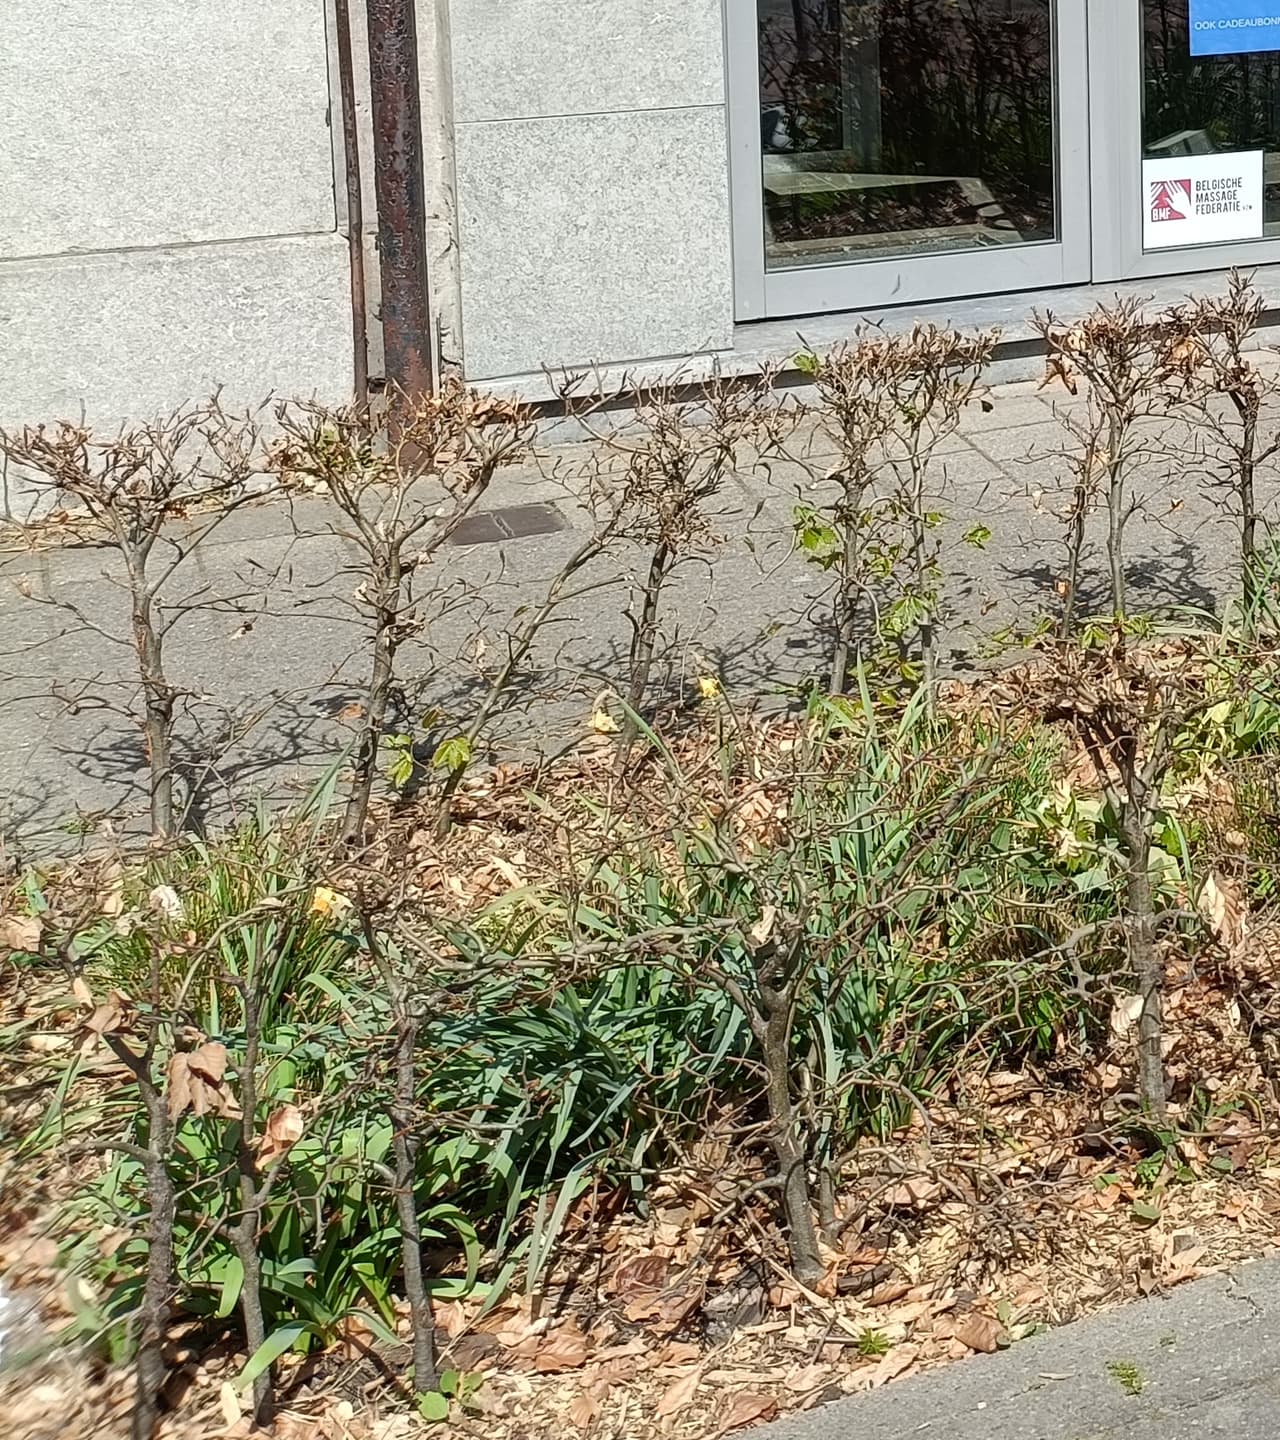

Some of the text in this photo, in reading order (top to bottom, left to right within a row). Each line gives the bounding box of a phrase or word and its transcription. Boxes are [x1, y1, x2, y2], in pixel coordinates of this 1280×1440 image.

[1194, 20, 1216, 31] OOK
[1195, 177, 1242, 192] BELGISCHE
[1195, 189, 1238, 204] MASSAGE
[1195, 201, 1241, 215] FEDERATIE
